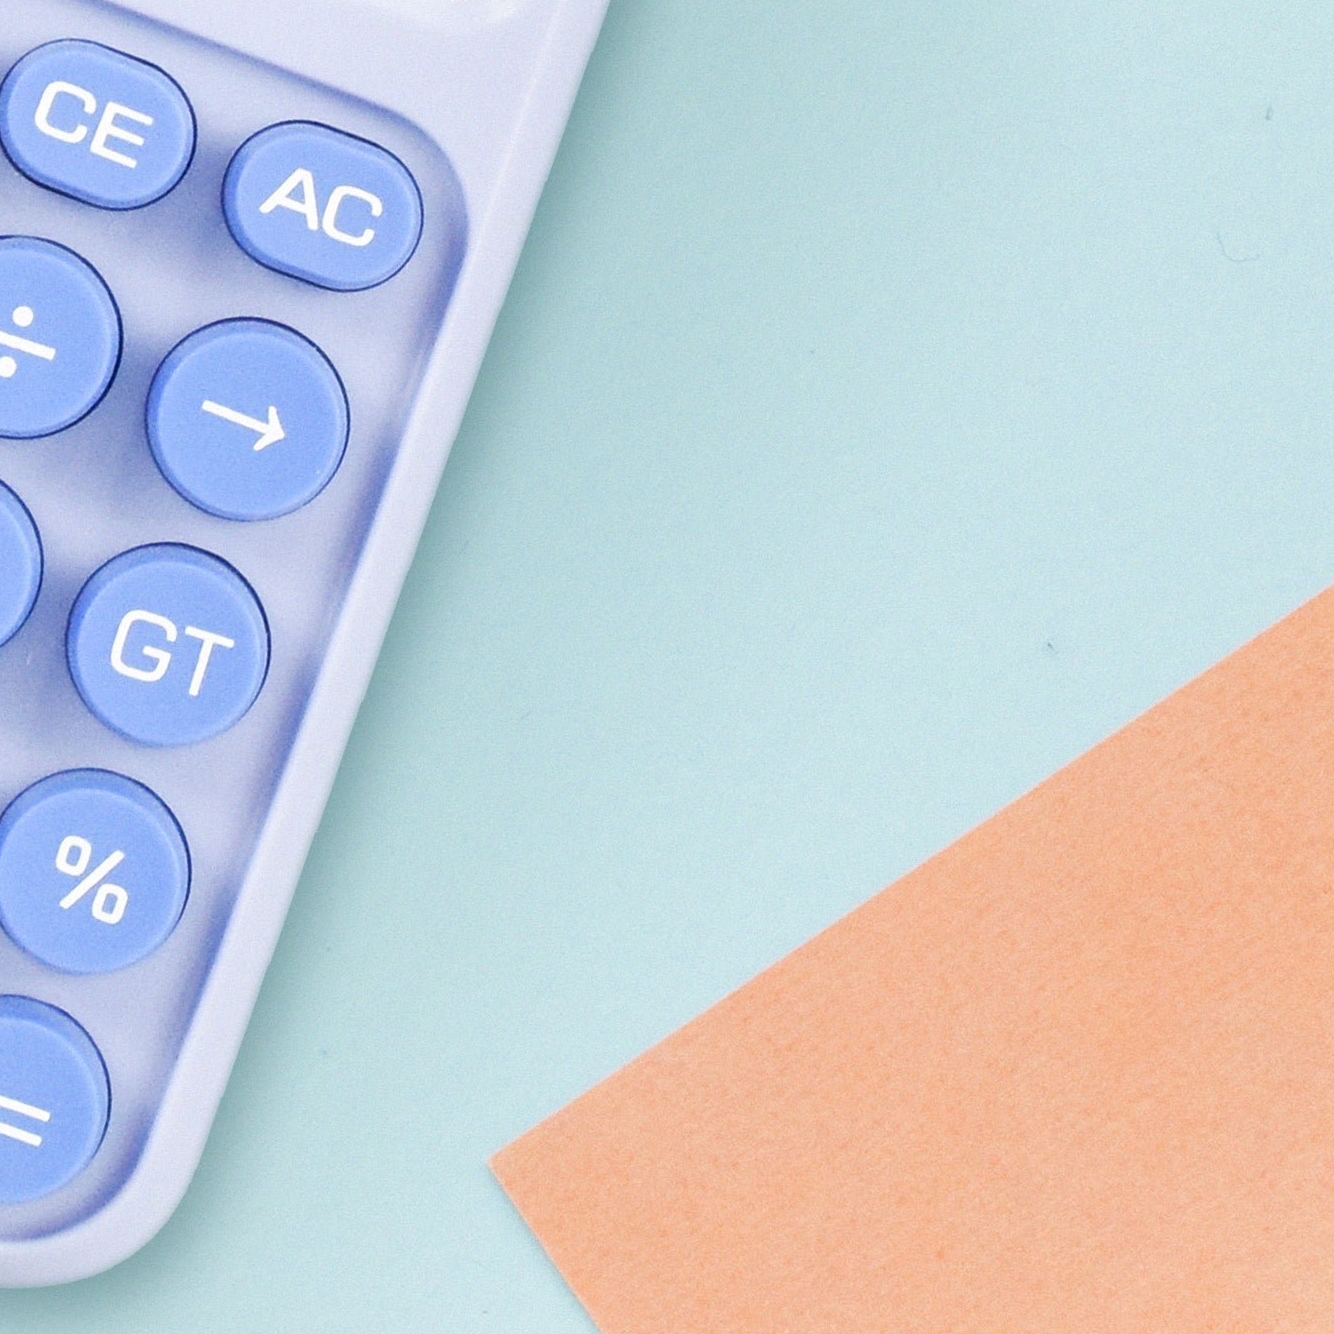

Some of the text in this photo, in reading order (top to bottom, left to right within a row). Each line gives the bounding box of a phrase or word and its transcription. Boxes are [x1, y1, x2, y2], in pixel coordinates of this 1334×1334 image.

[31, 79, 156, 171] CE
[256, 166, 386, 249] AC
[108, 607, 237, 698] GT
[53, 833, 131, 926] %
